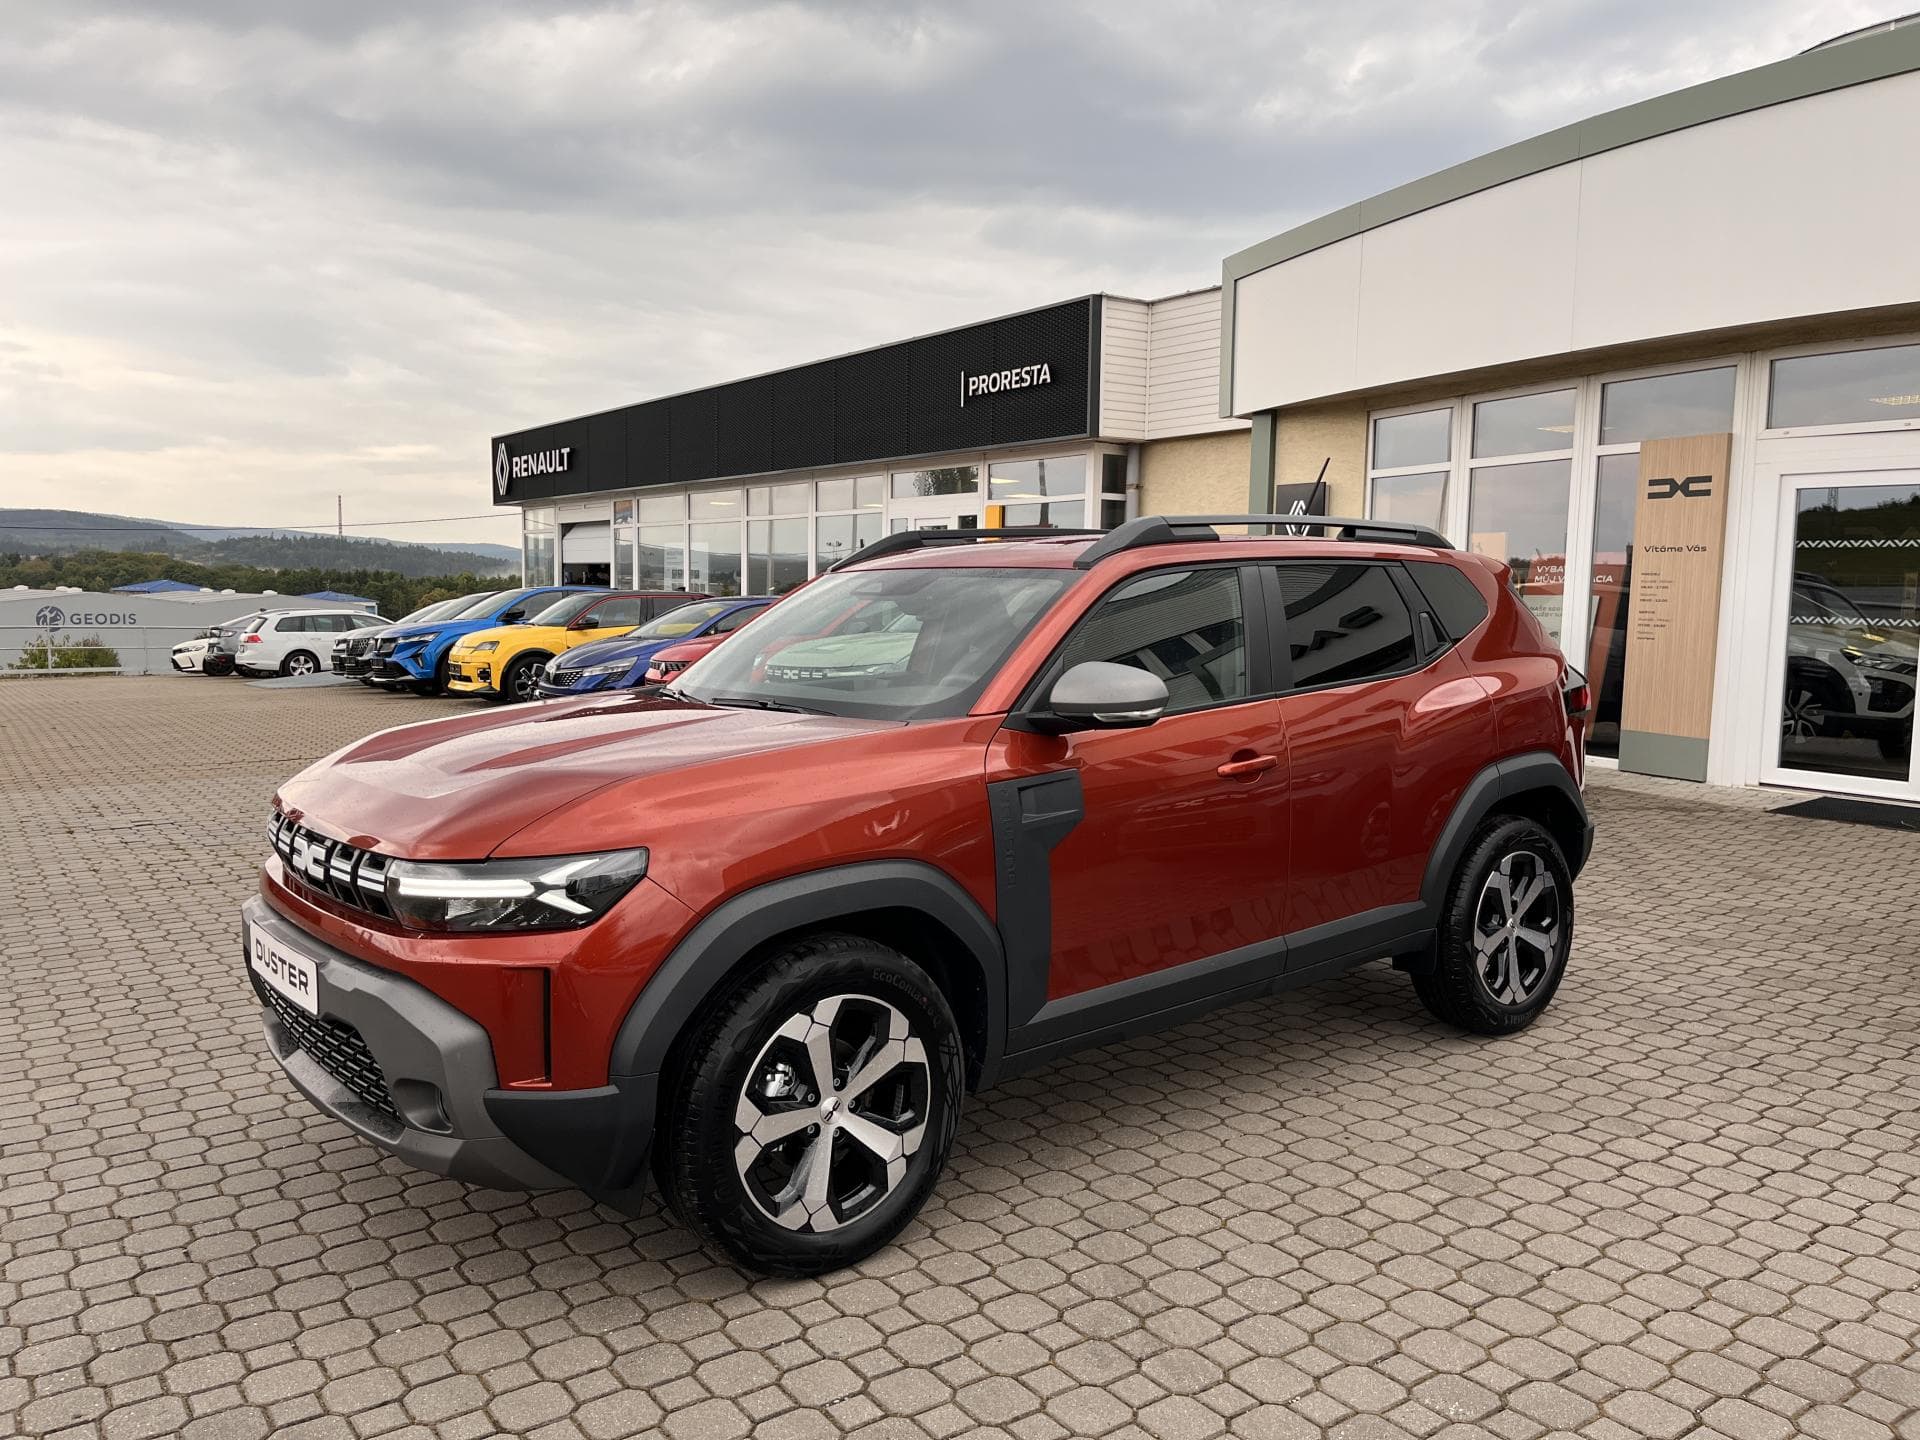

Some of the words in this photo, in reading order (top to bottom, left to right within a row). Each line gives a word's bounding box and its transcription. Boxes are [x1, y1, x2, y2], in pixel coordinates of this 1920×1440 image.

[968, 362, 1051, 397] PRORESTA
[512, 447, 571, 479] RENAULT
[1686, 544, 1707, 552] Vás
[1536, 565, 1565, 573] VYBA
[70, 613, 137, 625] GEODIS
[254, 938, 309, 995] DUSTER
[872, 967, 929, 1009] EcoConta
